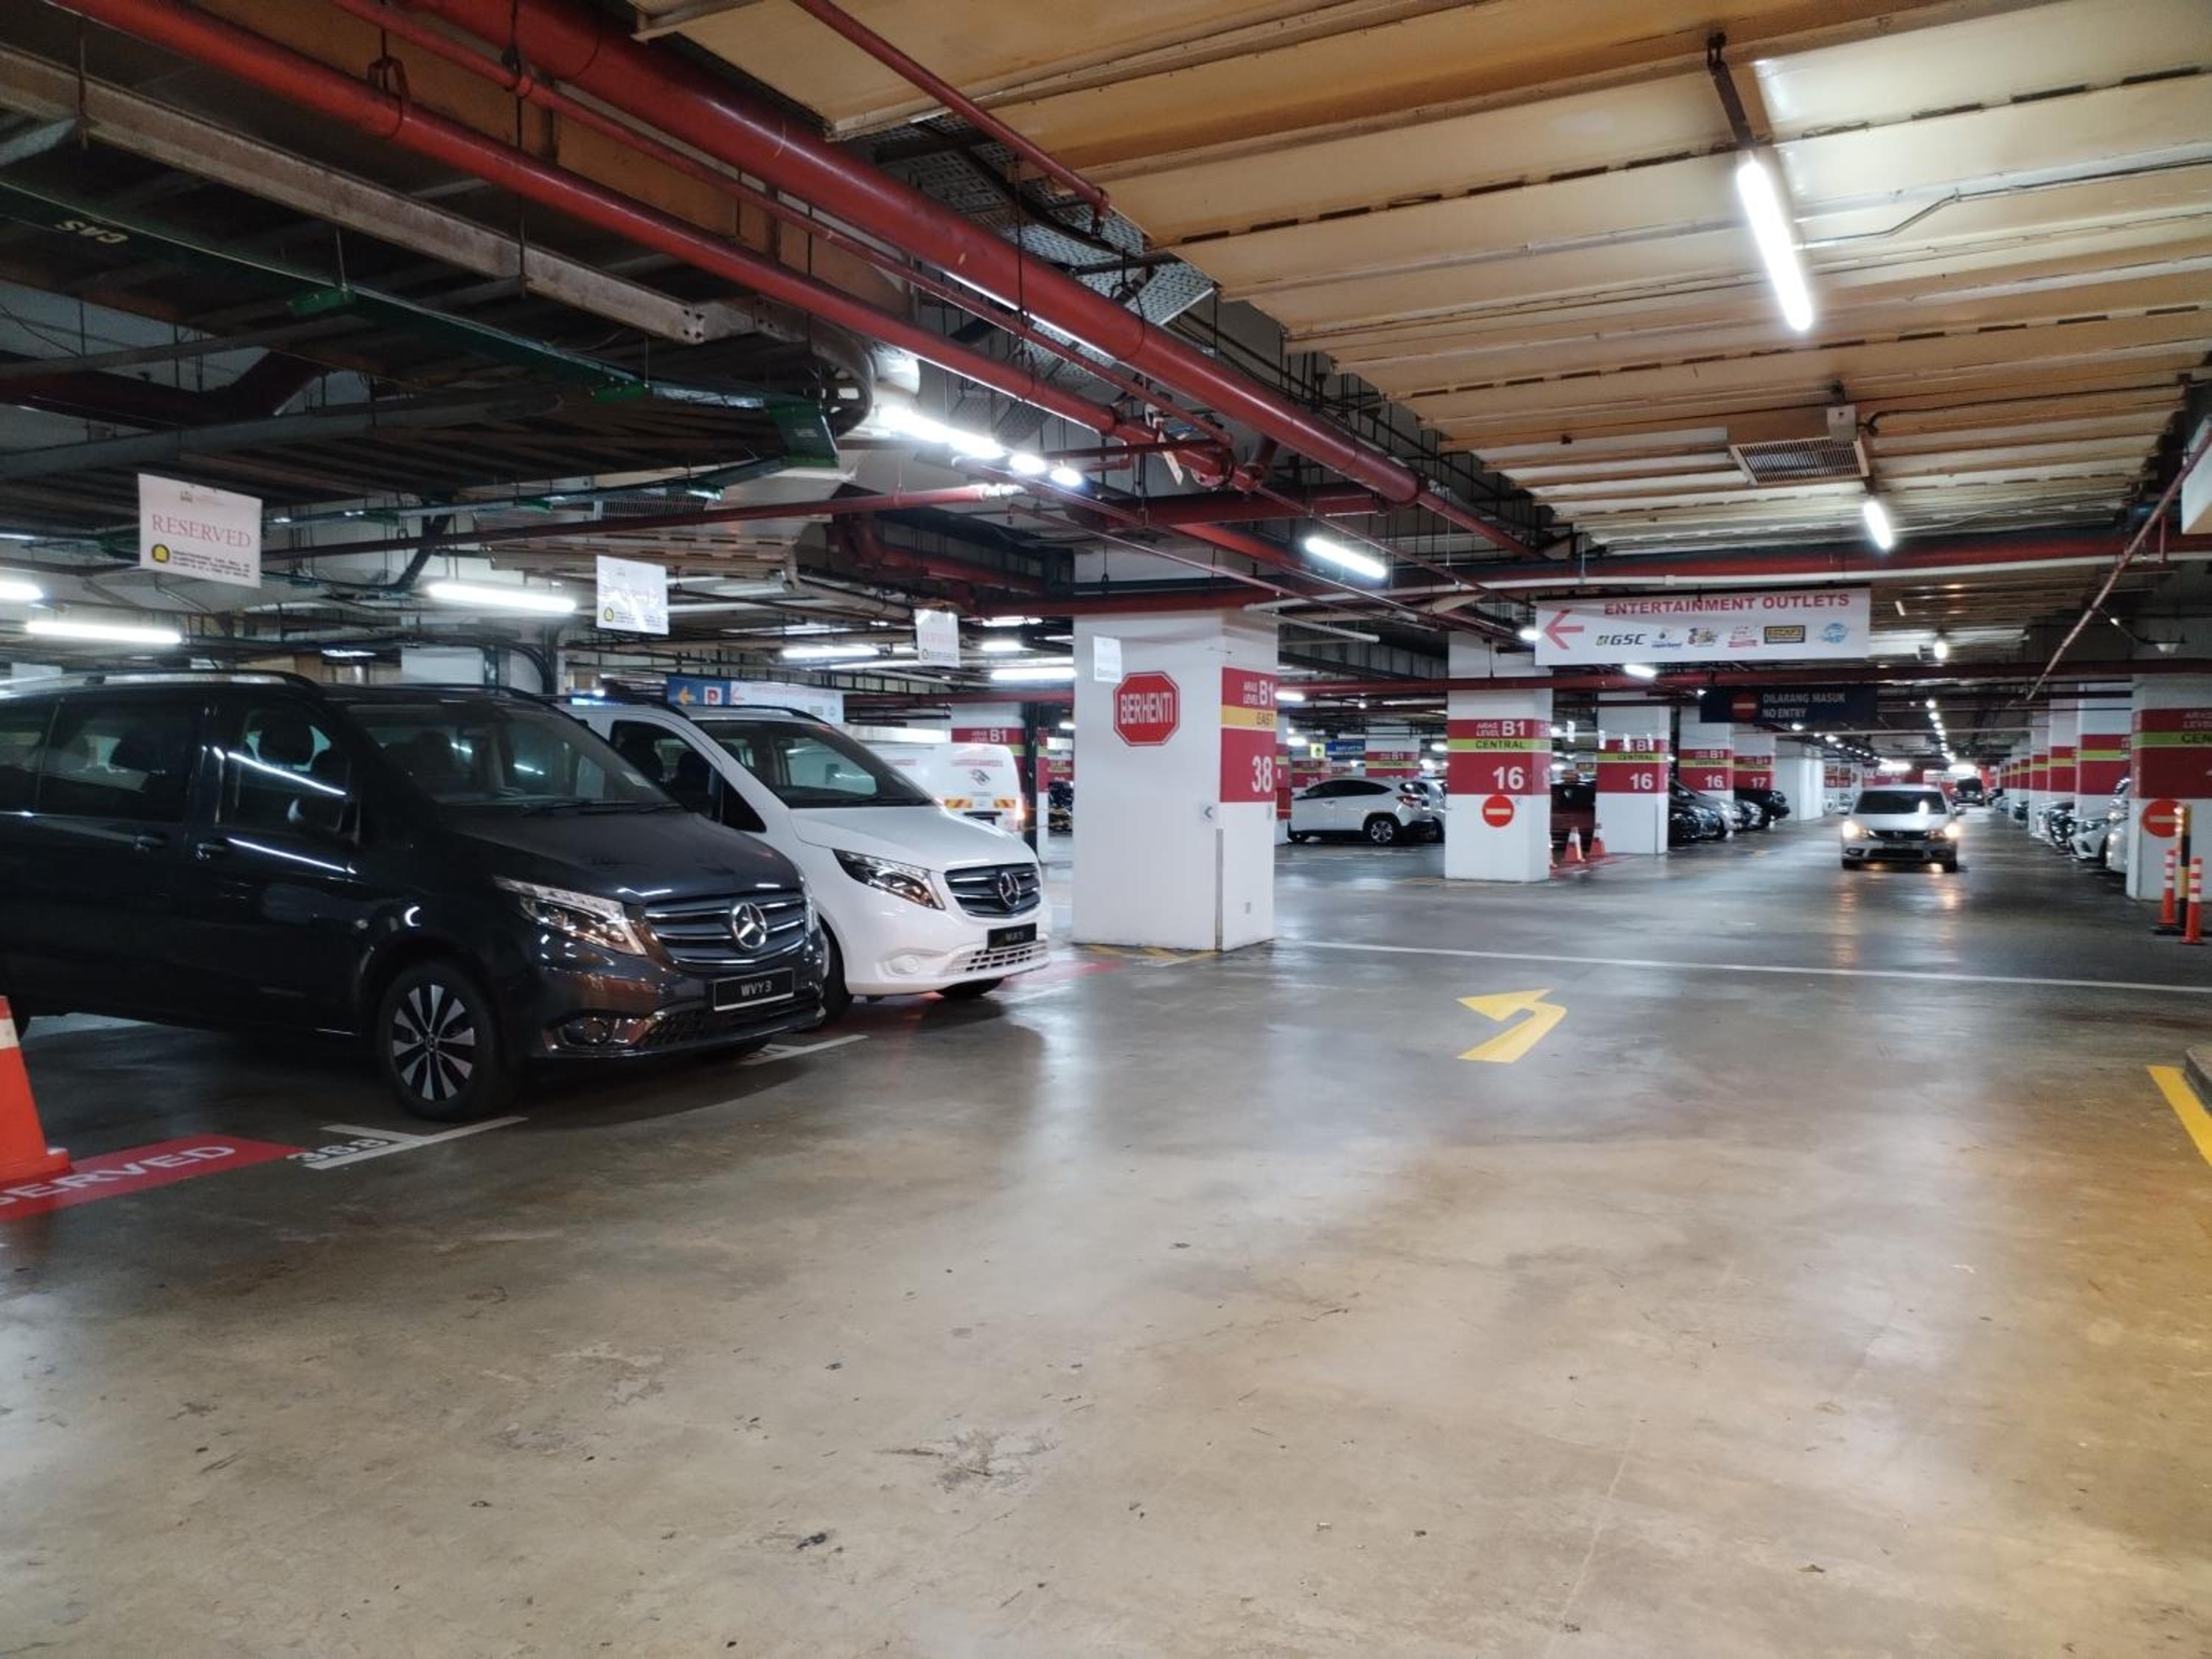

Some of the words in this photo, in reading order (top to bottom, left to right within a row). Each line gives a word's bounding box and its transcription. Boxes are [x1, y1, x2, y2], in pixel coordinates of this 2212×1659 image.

[153, 514, 251, 549] RESERVED
[1604, 597, 1756, 616] ENTERTAINMENT
[1763, 593, 1850, 609] OUTLETS
[1610, 633, 1647, 645] GSC
[1259, 679, 1274, 707] B1
[1763, 693, 1809, 703] DILARANG
[1812, 692, 1846, 703] MASUK
[1120, 692, 1174, 726] BERHENTI
[1762, 708, 1776, 718] NO
[1778, 707, 1806, 718] ENTRY
[990, 729, 1007, 743] B1
[1502, 720, 1526, 737] B1
[1475, 740, 1524, 749] CENTRAL
[1711, 751, 1723, 759] B1
[1251, 755, 1273, 793] 38
[1492, 766, 1524, 790] 16
[1630, 773, 1653, 790] 16
[1704, 775, 1723, 788] 16
[1751, 776, 1767, 789] 17
[0, 1147, 236, 1206] ERVED
